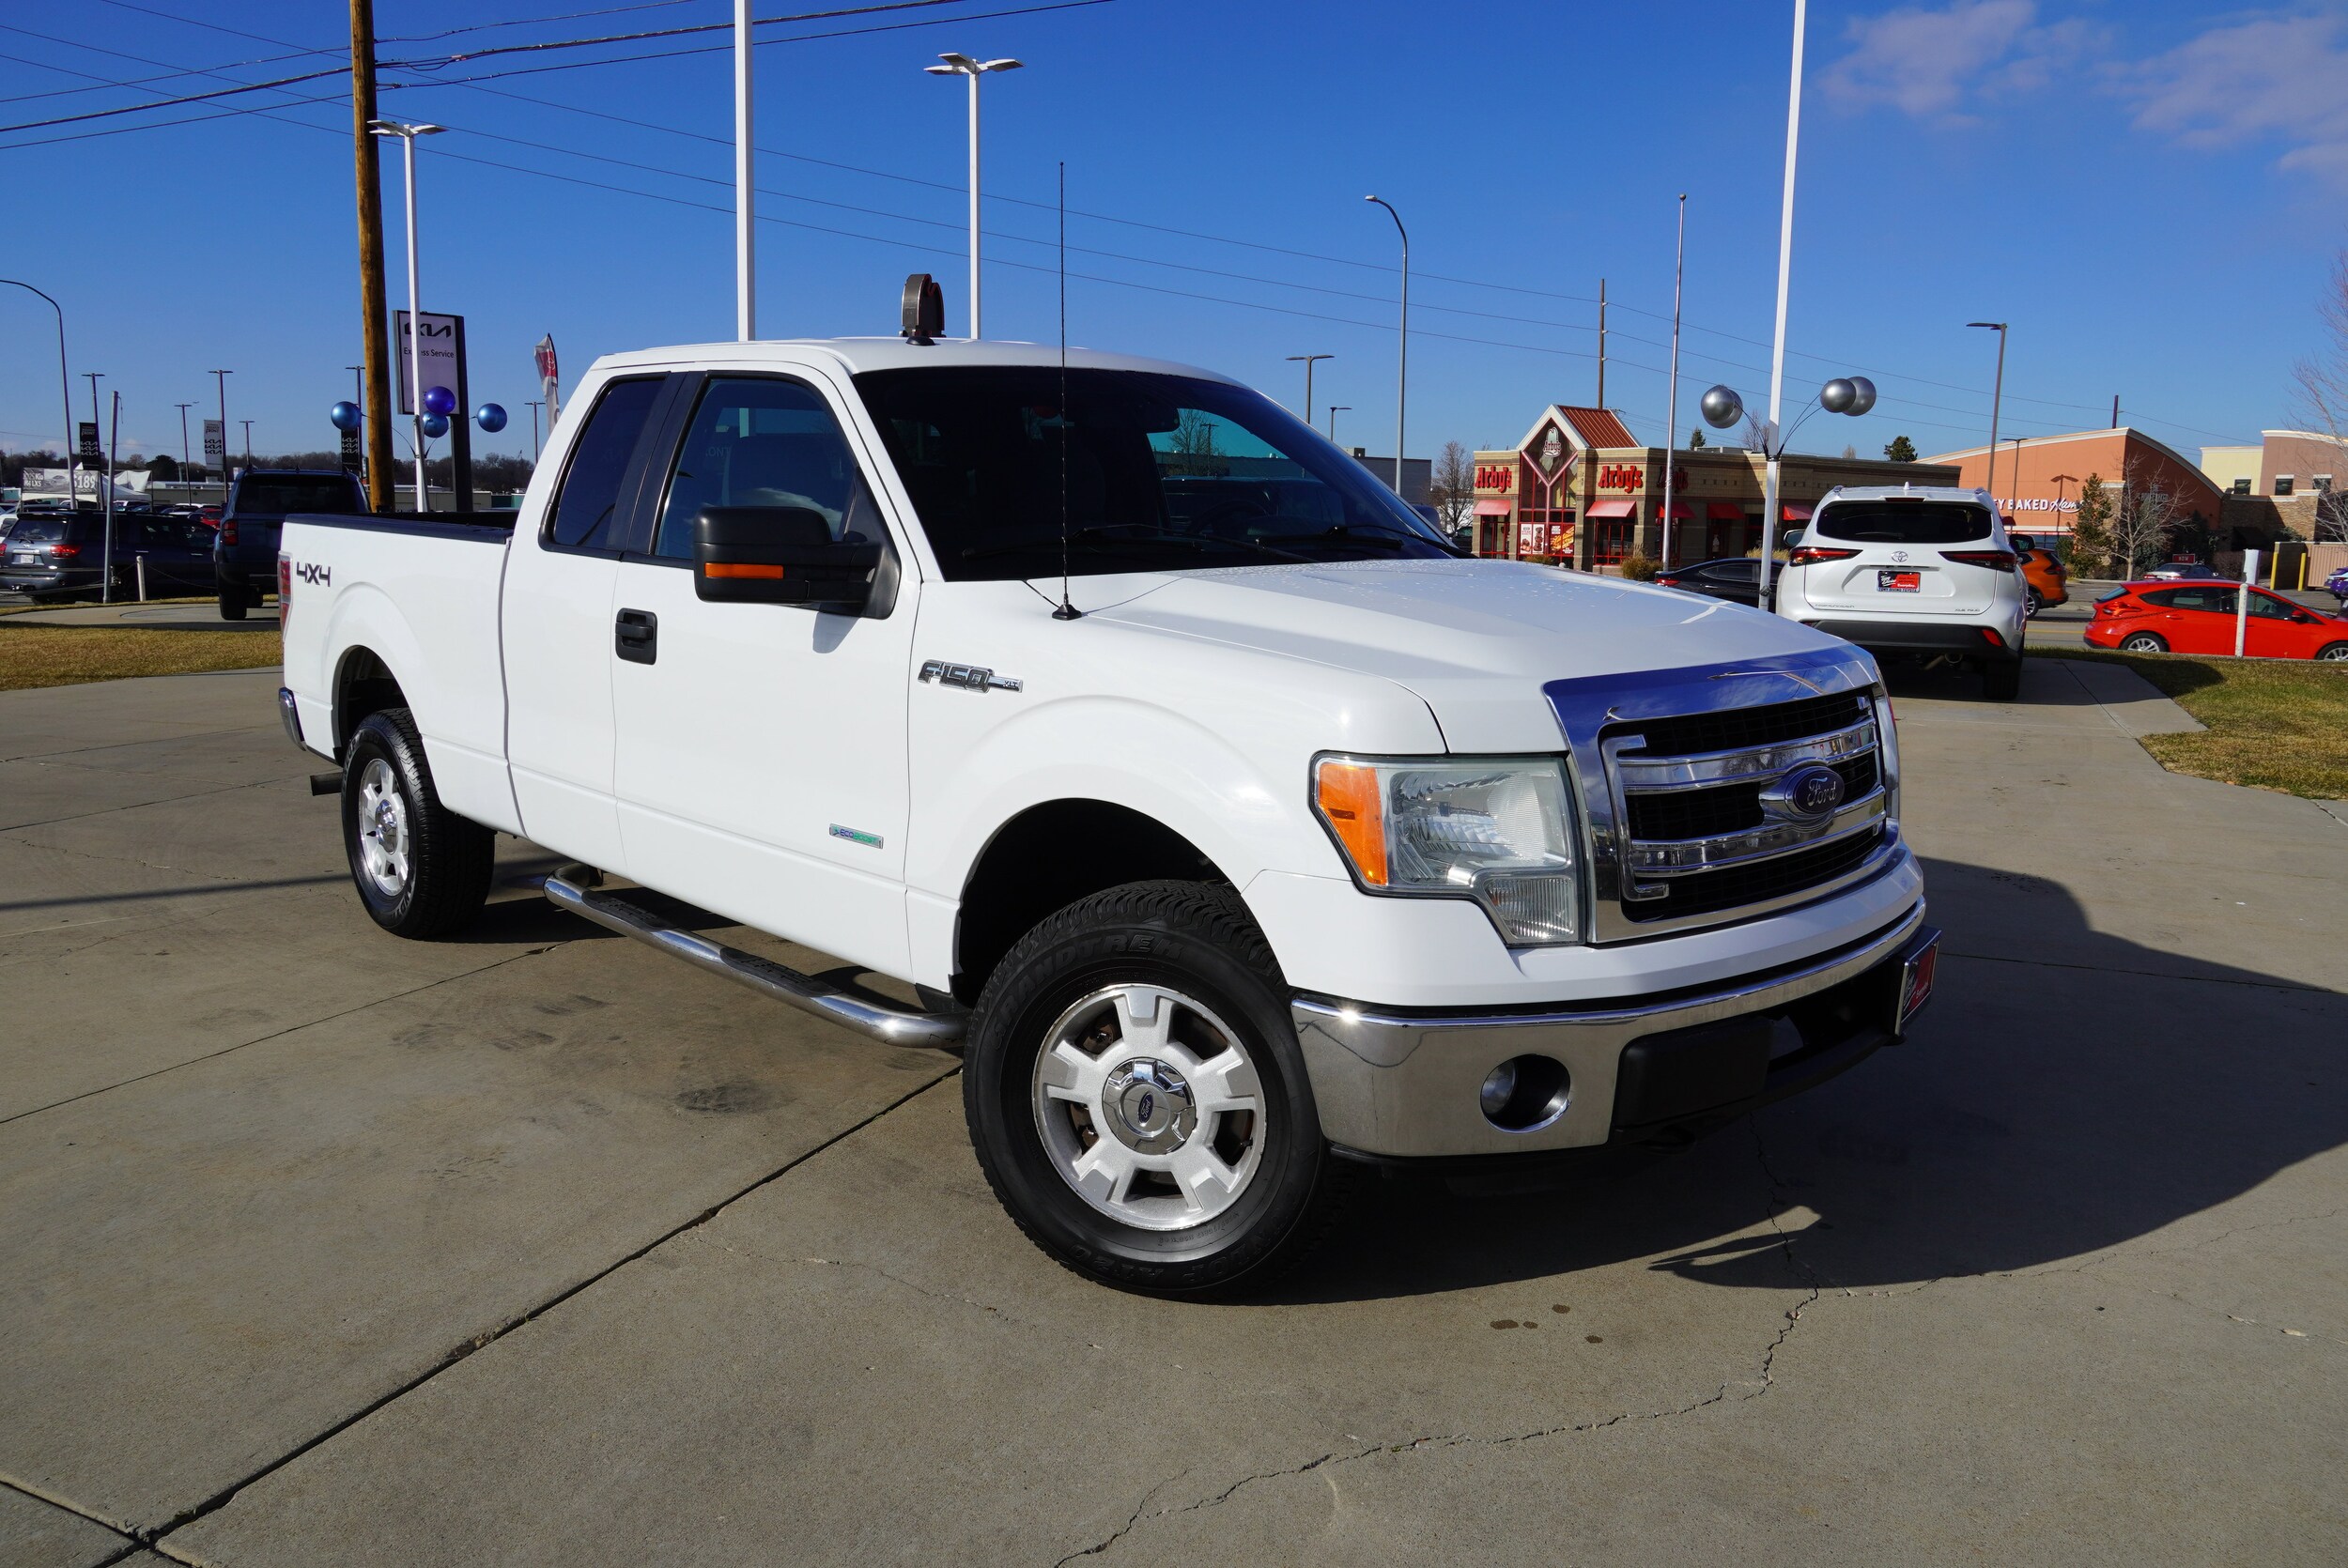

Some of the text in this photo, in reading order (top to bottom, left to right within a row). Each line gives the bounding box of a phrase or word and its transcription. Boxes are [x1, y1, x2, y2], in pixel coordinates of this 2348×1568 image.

[404, 347, 455, 359] Exss Service
[1543, 439, 1561, 452] Arby's
[1475, 466, 1512, 493] Arby's
[1598, 465, 1643, 494] Arby's
[2008, 499, 2048, 511] BAKED
[1003, 680, 1019, 688] XLT
[1807, 776, 1837, 807] Ford
[1140, 1099, 1151, 1118] Ford
